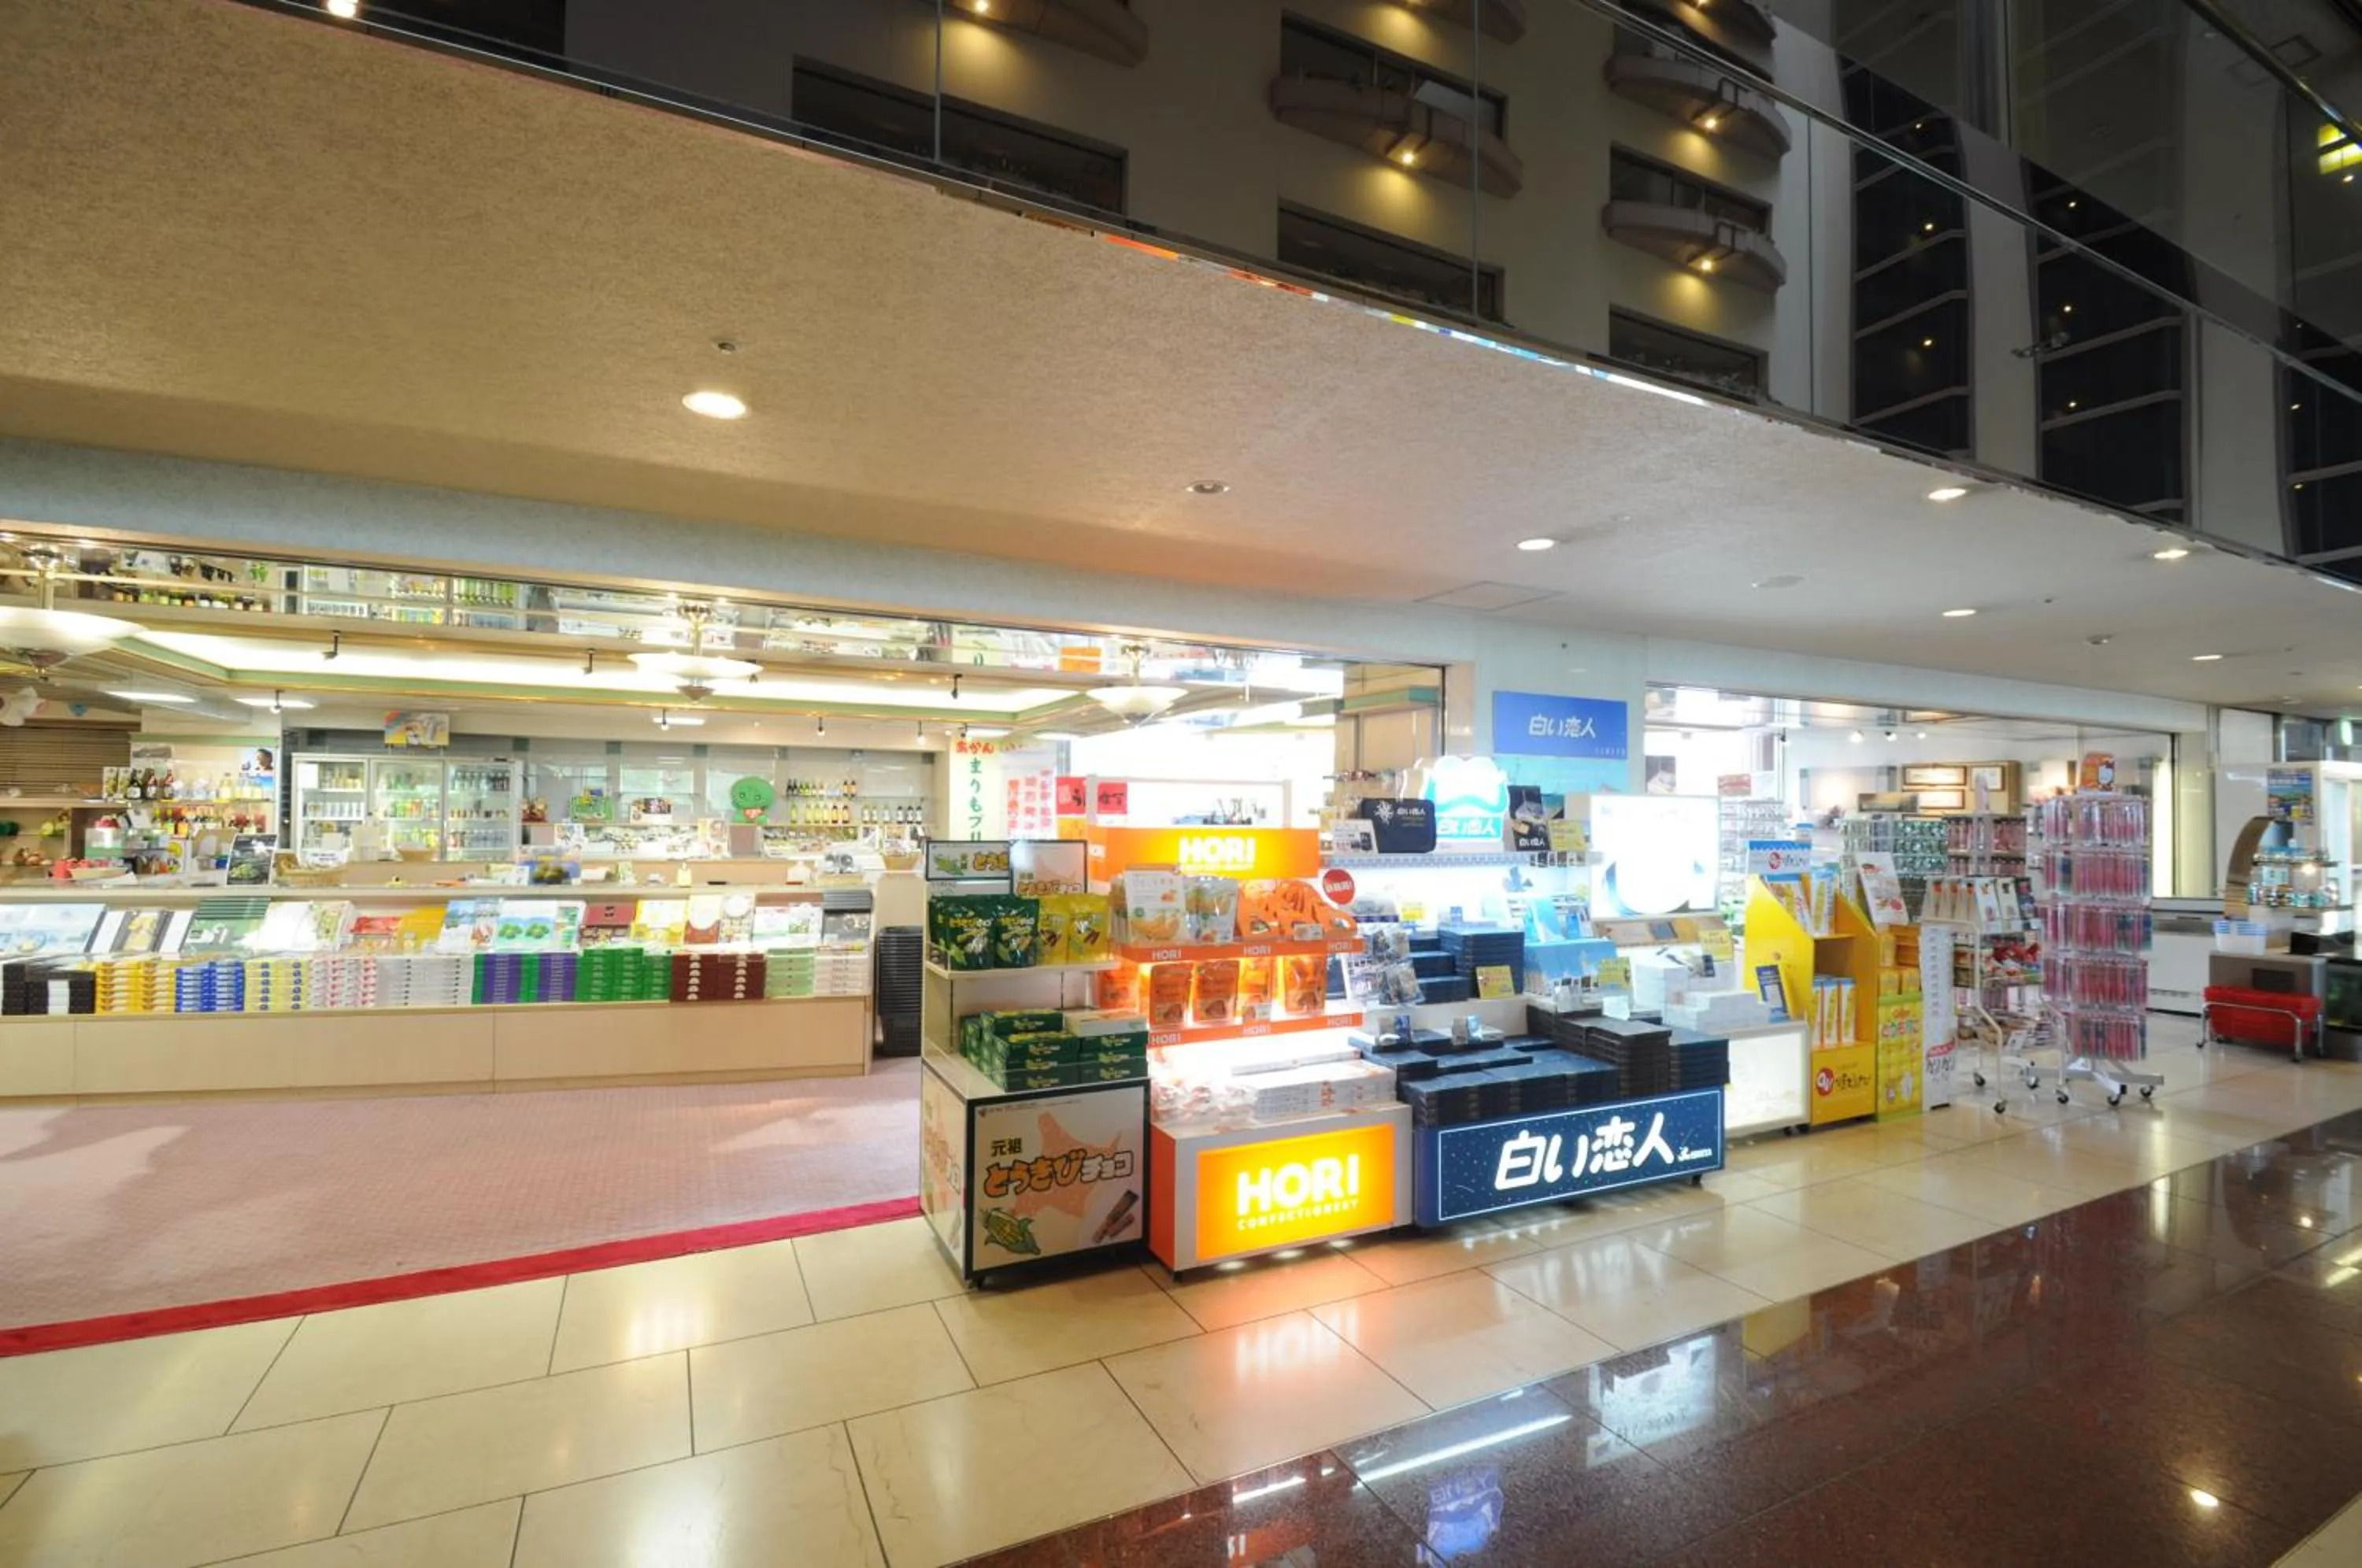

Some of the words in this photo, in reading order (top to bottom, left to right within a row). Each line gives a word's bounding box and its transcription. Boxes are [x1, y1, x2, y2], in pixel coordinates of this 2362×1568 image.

[1528, 713, 1596, 738] 白い恋人
[1179, 837, 1256, 864] HORI
[1152, 949, 1182, 960] HORI
[1243, 945, 1271, 955] HORI
[1151, 1034, 1181, 1045] HORI
[990, 1138, 1023, 1157] 元祖
[1494, 1111, 1675, 1191] 白い恋人
[983, 1148, 1135, 1198] とうきびチョコ
[1237, 1154, 1361, 1216] HORI
